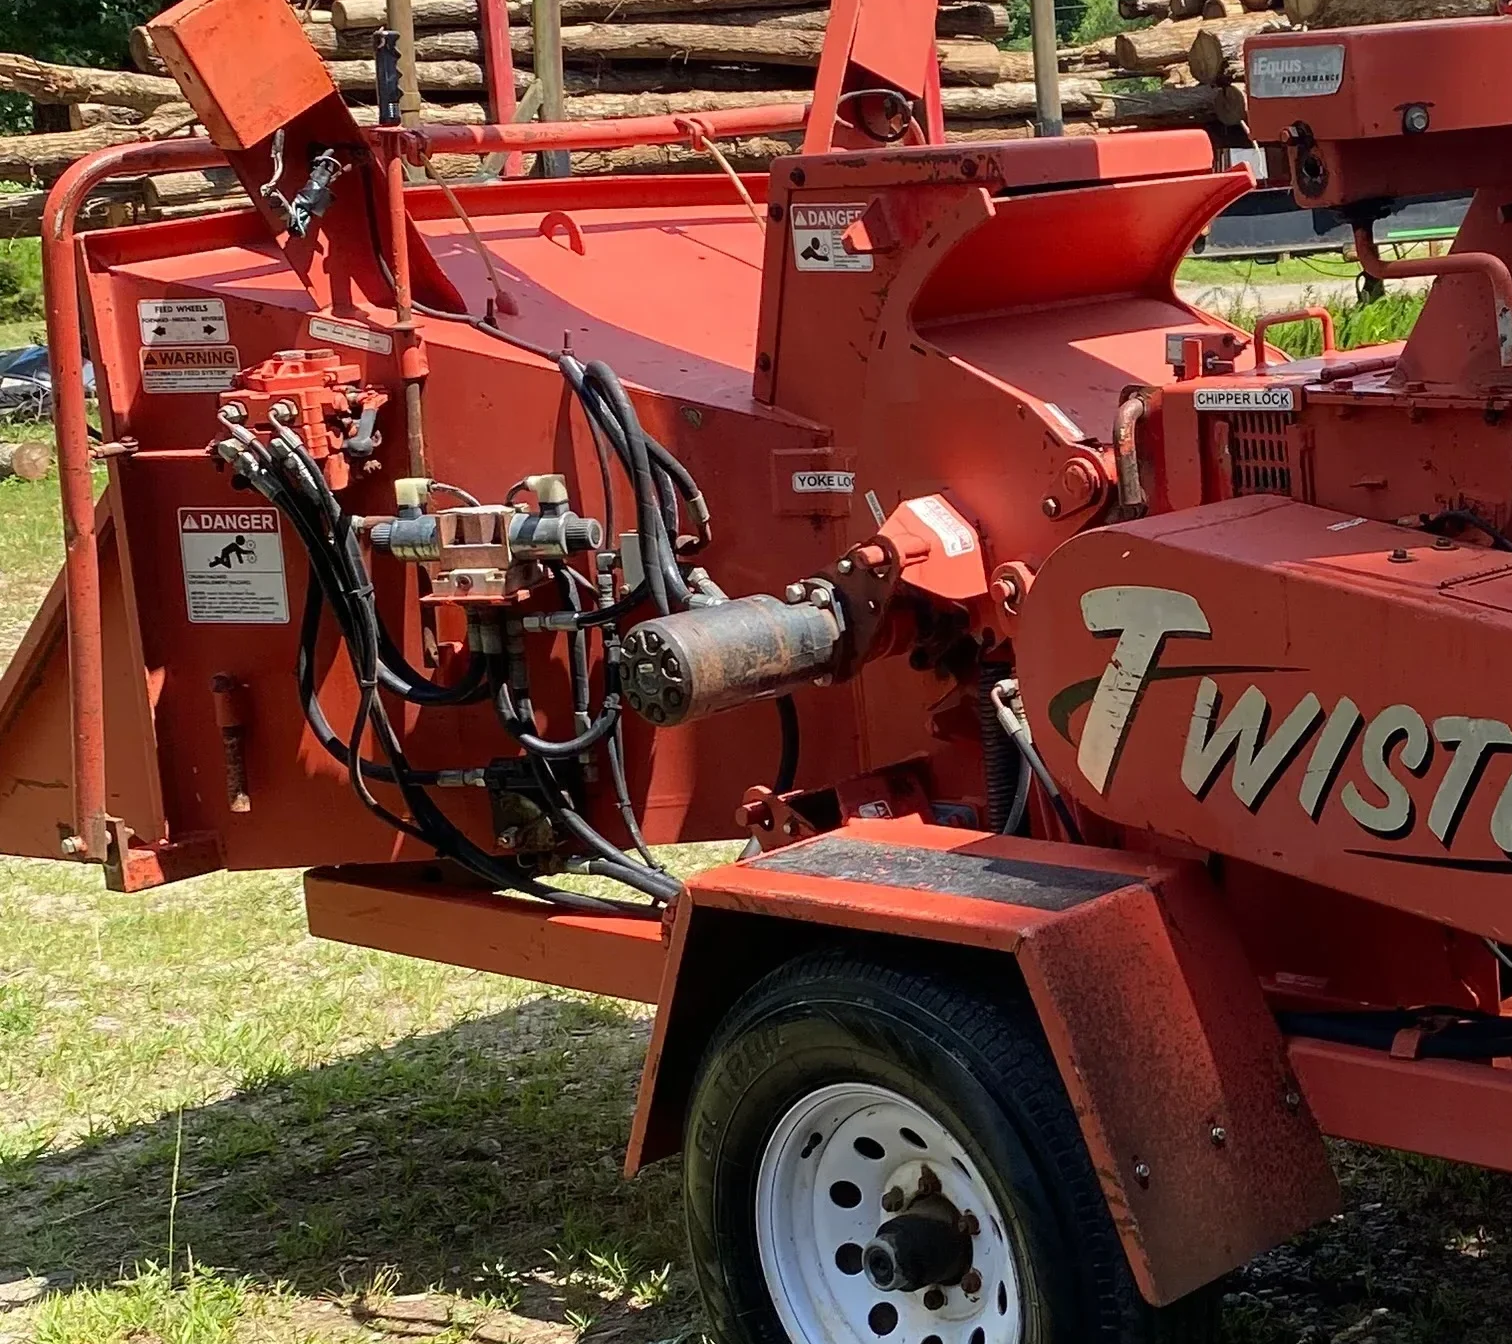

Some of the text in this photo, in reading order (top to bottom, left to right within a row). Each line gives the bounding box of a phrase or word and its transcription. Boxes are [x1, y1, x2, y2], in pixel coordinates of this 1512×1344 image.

[176, 304, 208, 313] WHEELS
[161, 351, 235, 365] WARNING
[1198, 393, 1289, 405] CHIPPER LOCK
[798, 476, 834, 488] YOKE
[200, 514, 275, 530] DANGER
